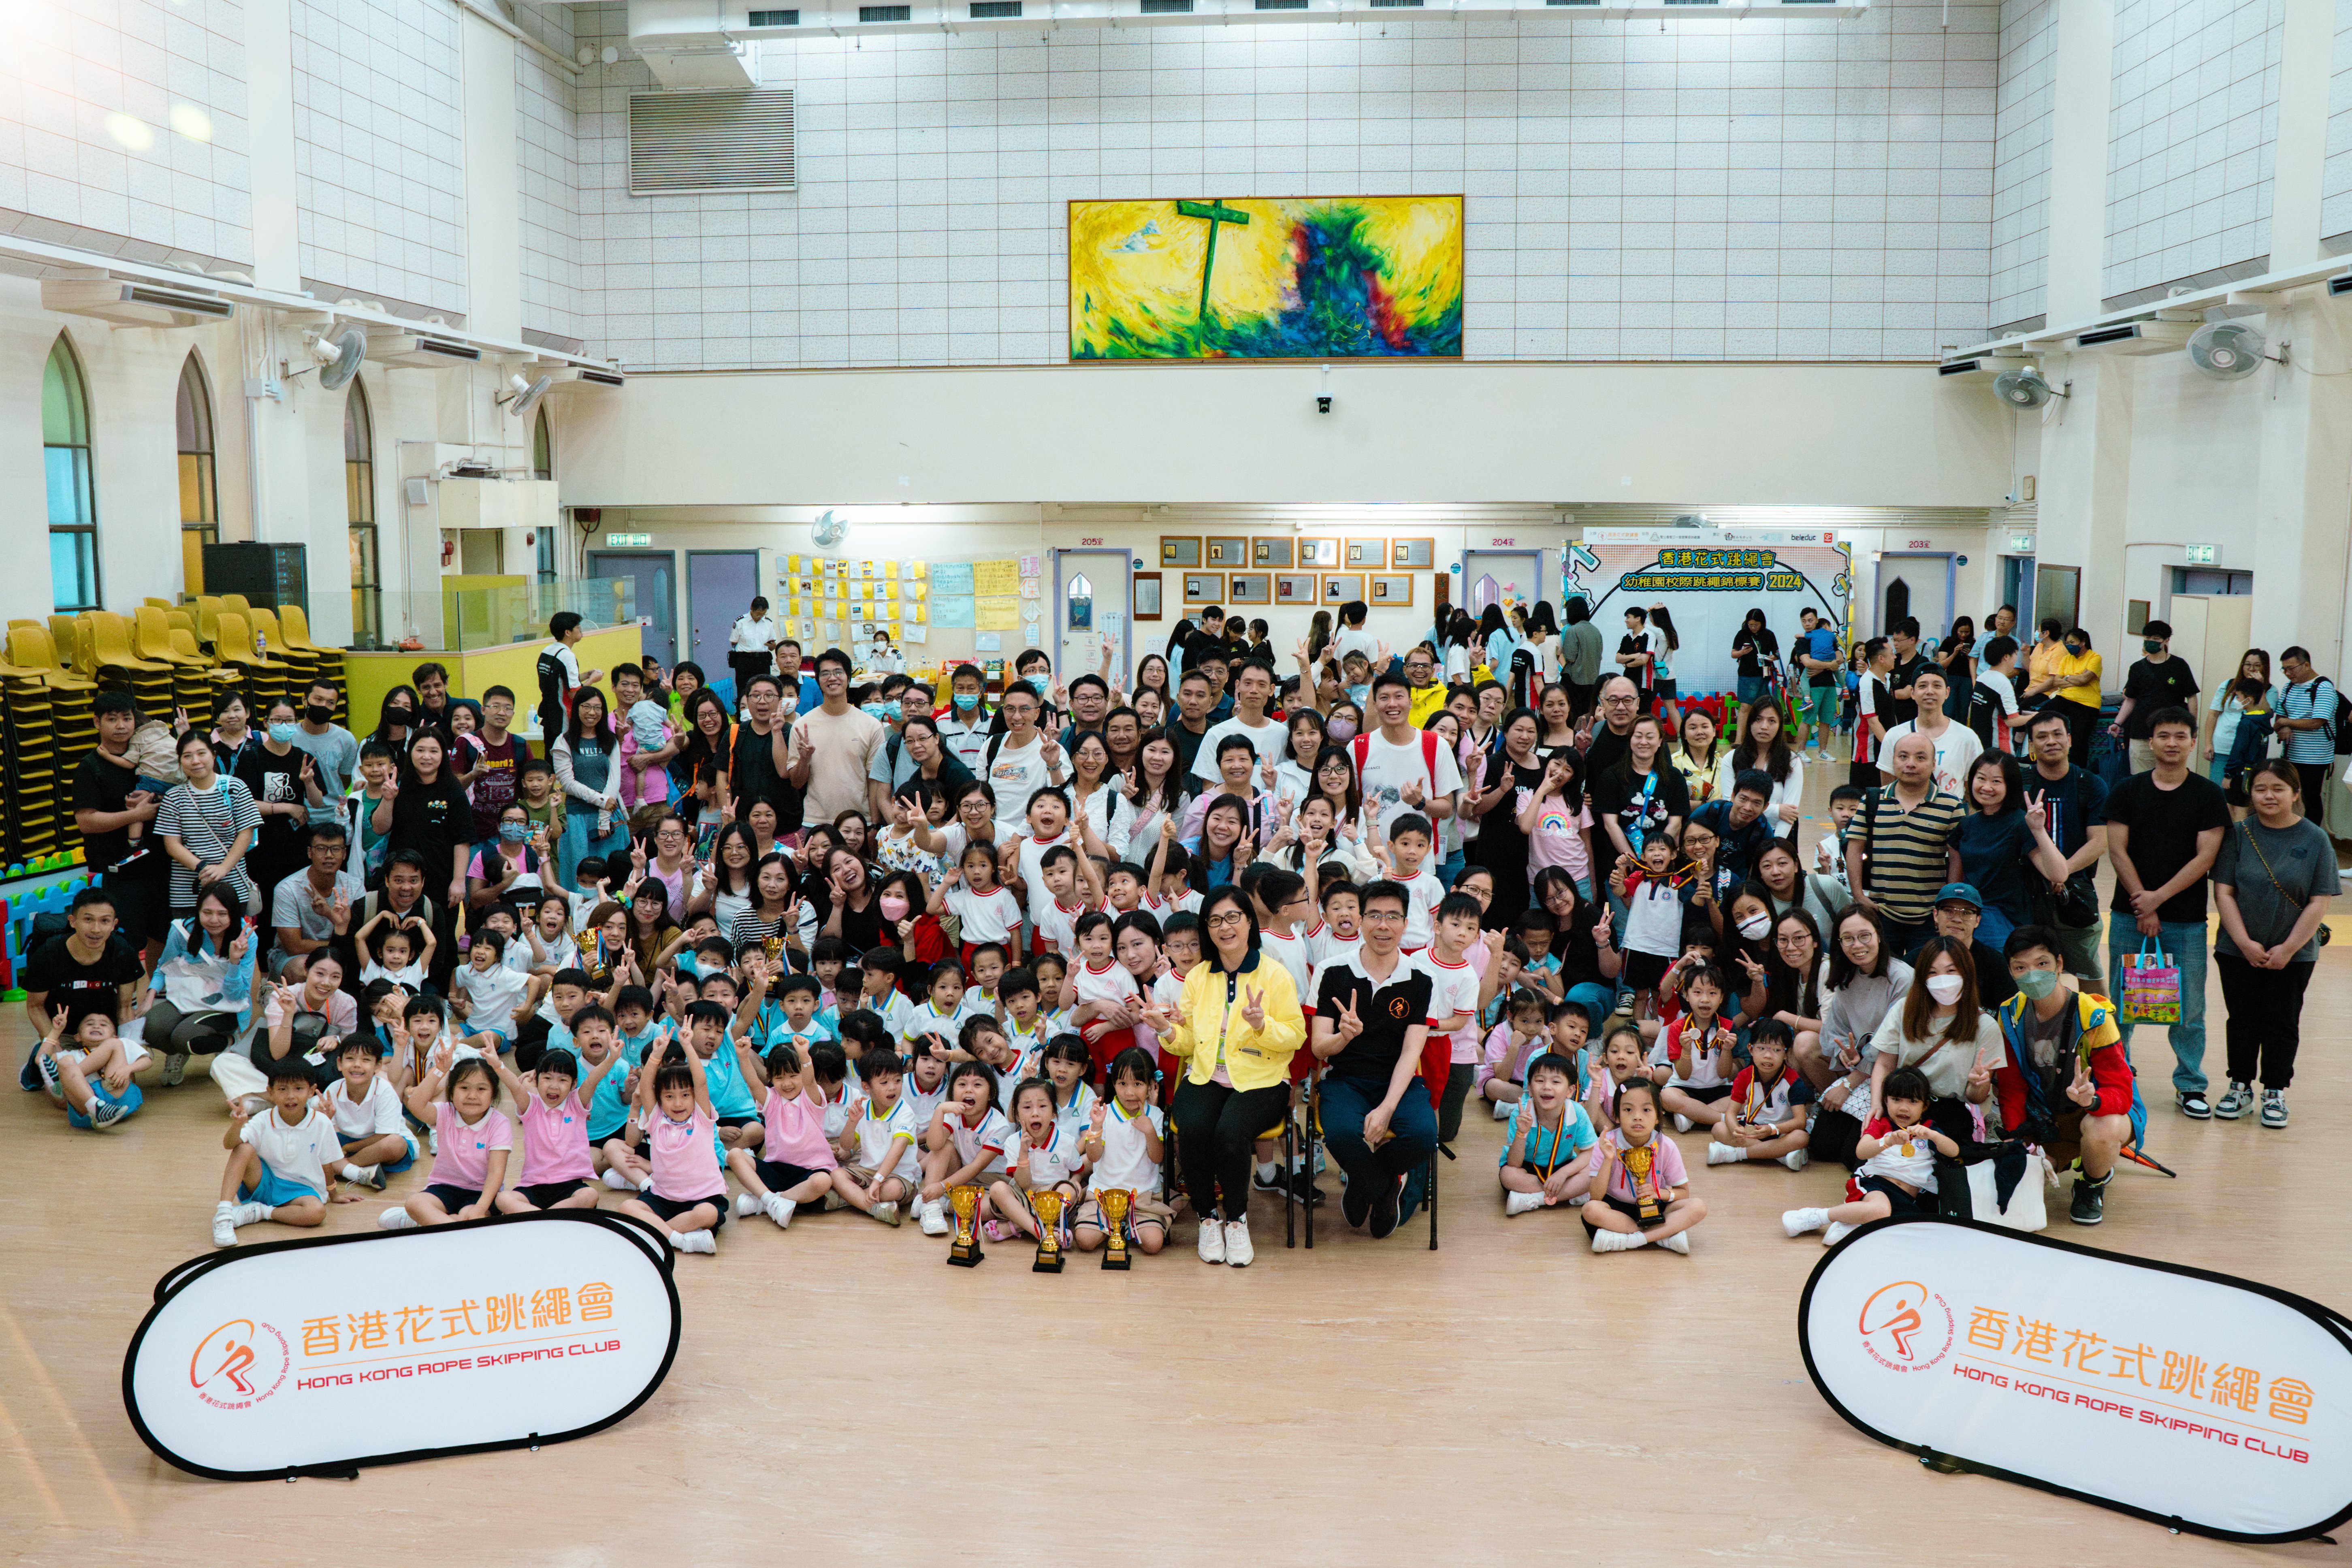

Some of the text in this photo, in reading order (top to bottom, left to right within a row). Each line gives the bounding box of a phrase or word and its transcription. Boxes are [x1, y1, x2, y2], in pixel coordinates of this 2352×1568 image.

[611, 534, 647, 546] EXIT 出口
[1492, 538, 1515, 546] 204室
[1908, 540, 1930, 548] 203室
[1661, 551, 1774, 566] 香港花式跳繩會
[2188, 546, 2200, 561] EXIT
[1624, 574, 1802, 589] 幼稚園校際跳繩錦標賽 2024
[509, 758, 514, 767] 2
[301, 1282, 614, 1357] 香港花式跳繩會
[1912, 1293, 1955, 1372] Hong Kong Rope Skipping Club
[256, 1322, 290, 1403] Hong Kong Rope Skipping Club
[297, 1340, 621, 1391] HONG KONG ROPE SKIPPING CLUB
[1862, 1340, 1908, 1373] 香港花式跳繩會
[1967, 1306, 2315, 1425] 香港花式跳繩會
[198, 1392, 252, 1410] 香港花式跳繩會
[1953, 1363, 2309, 1463] HONG KONG ROPE SKIPPING CLUB
